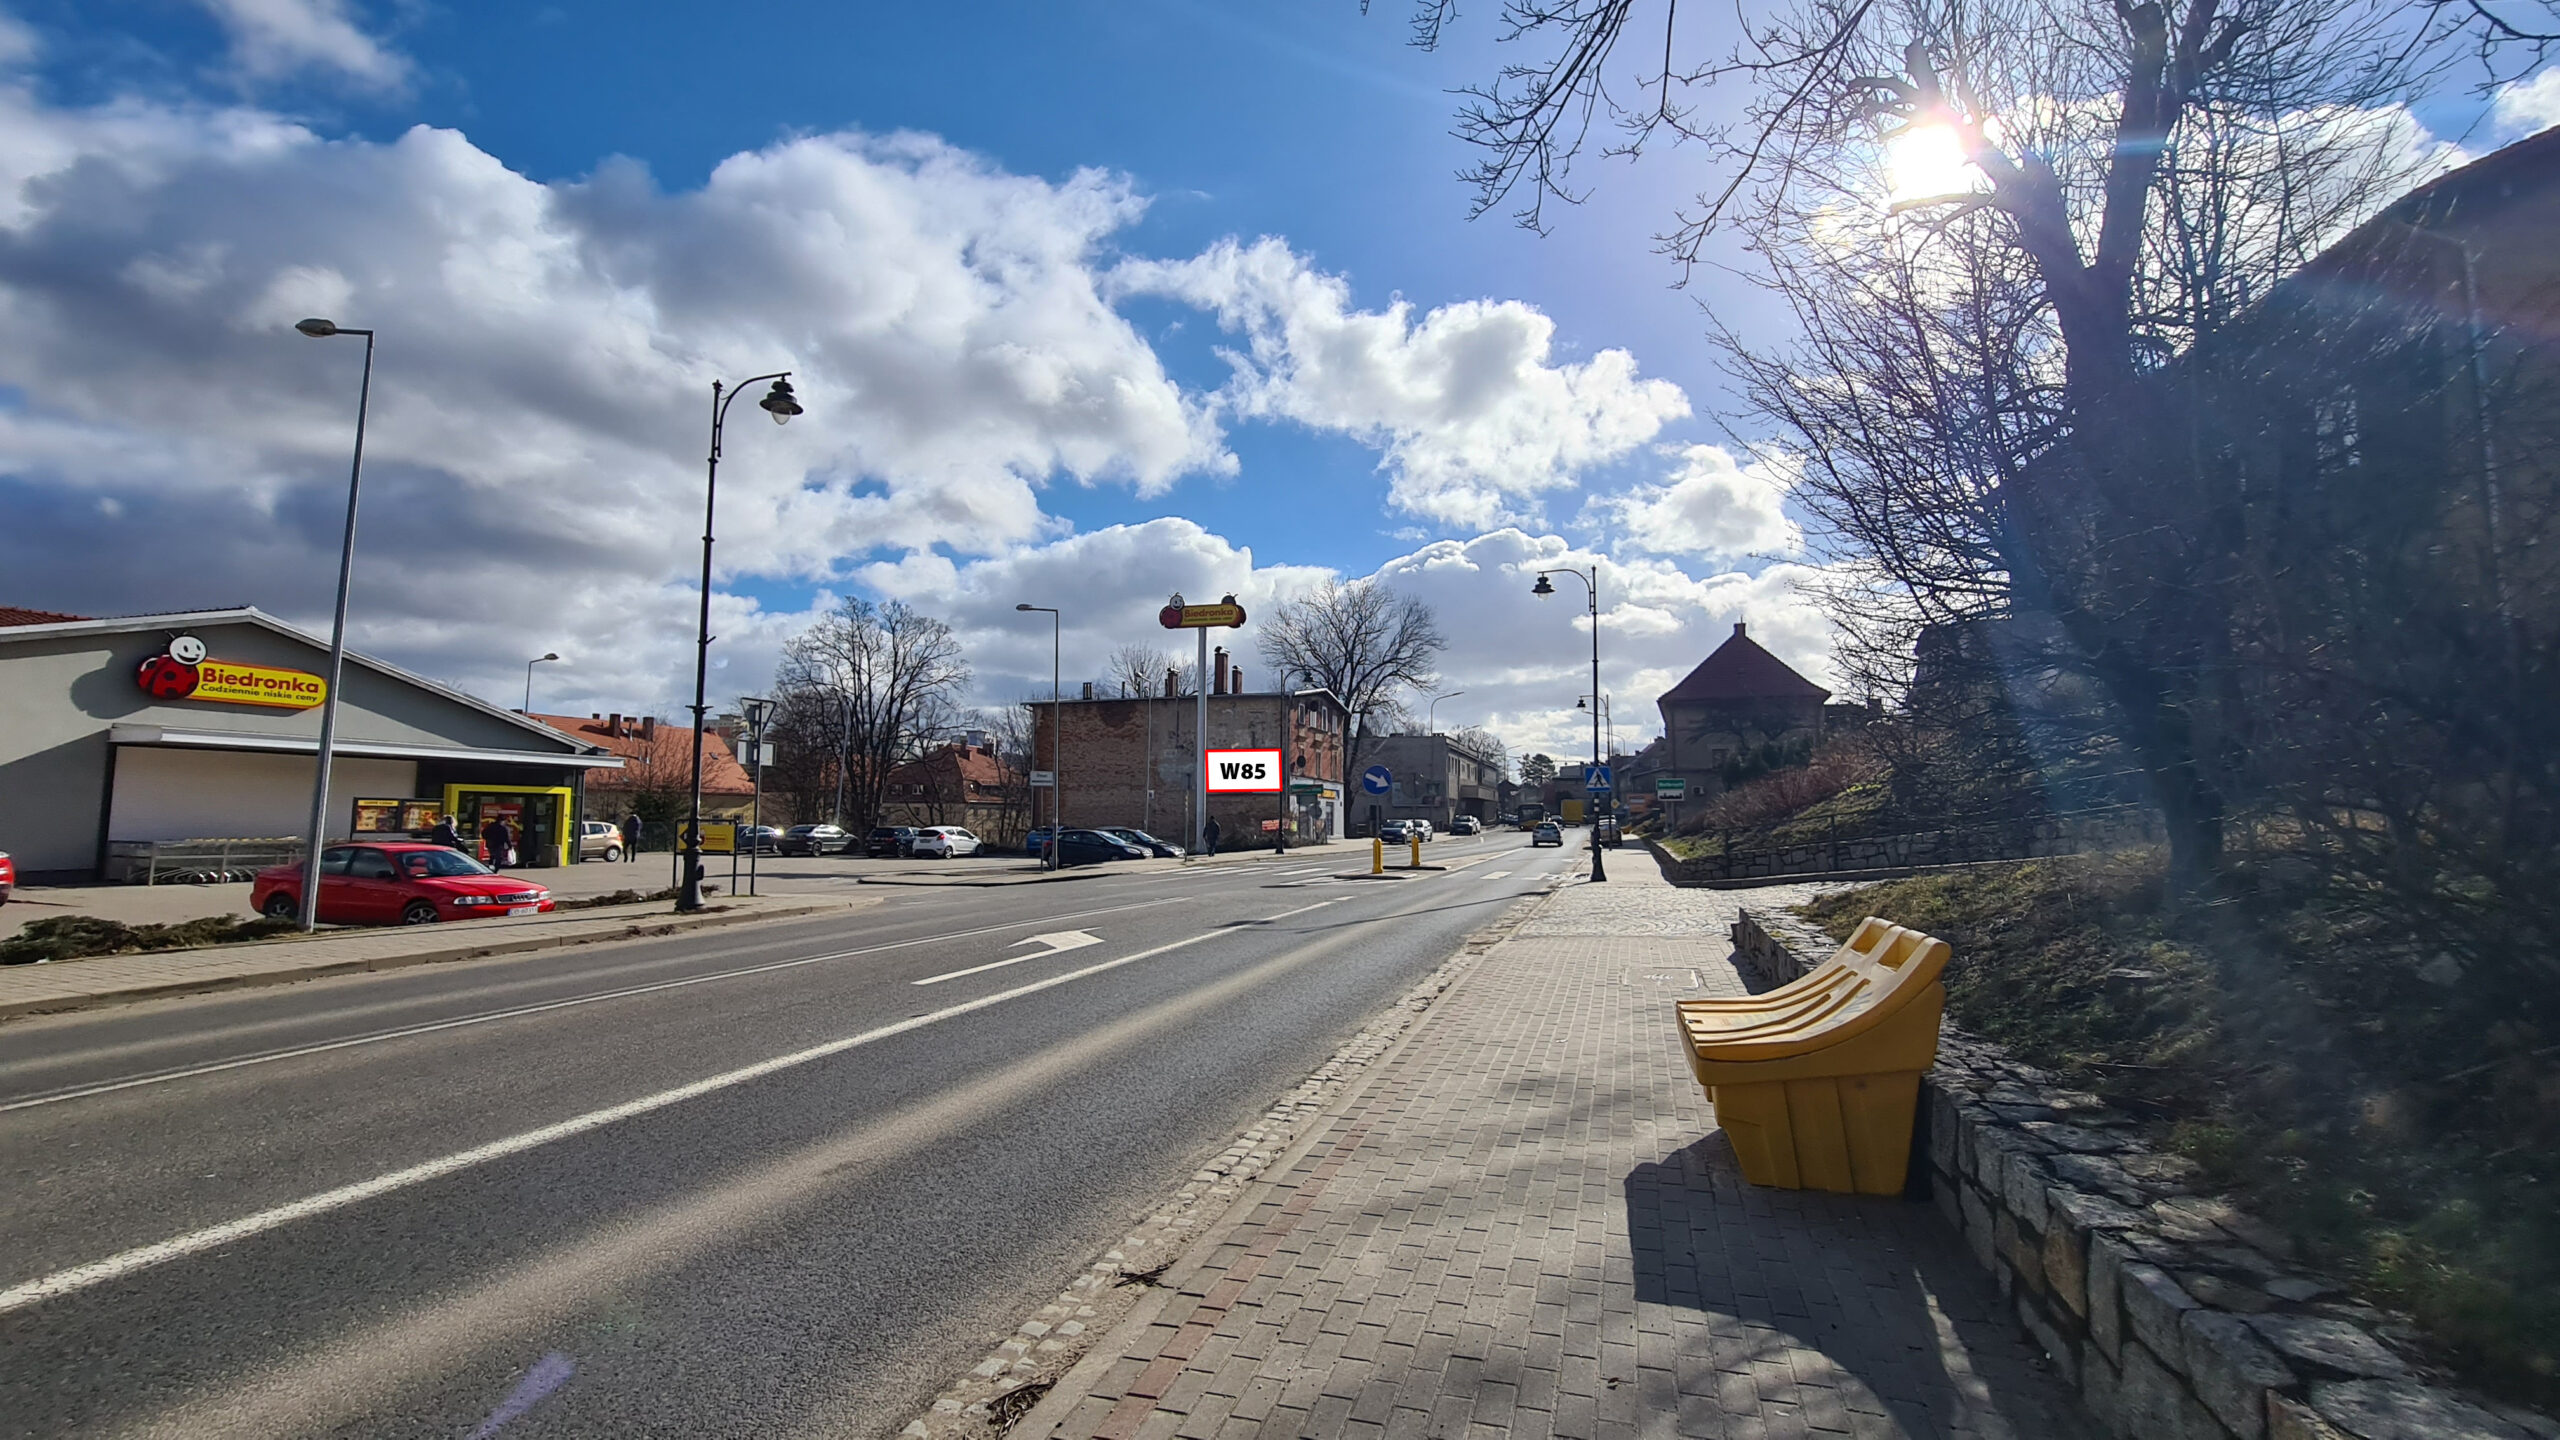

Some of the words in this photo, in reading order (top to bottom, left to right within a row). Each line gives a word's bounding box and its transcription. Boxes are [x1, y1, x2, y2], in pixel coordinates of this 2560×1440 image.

[1184, 608, 1234, 619] Biedronka
[202, 667, 320, 694] Biedronka
[200, 683, 260, 697] Codziennie
[263, 690, 292, 699] niskie
[295, 693, 318, 703] ceny
